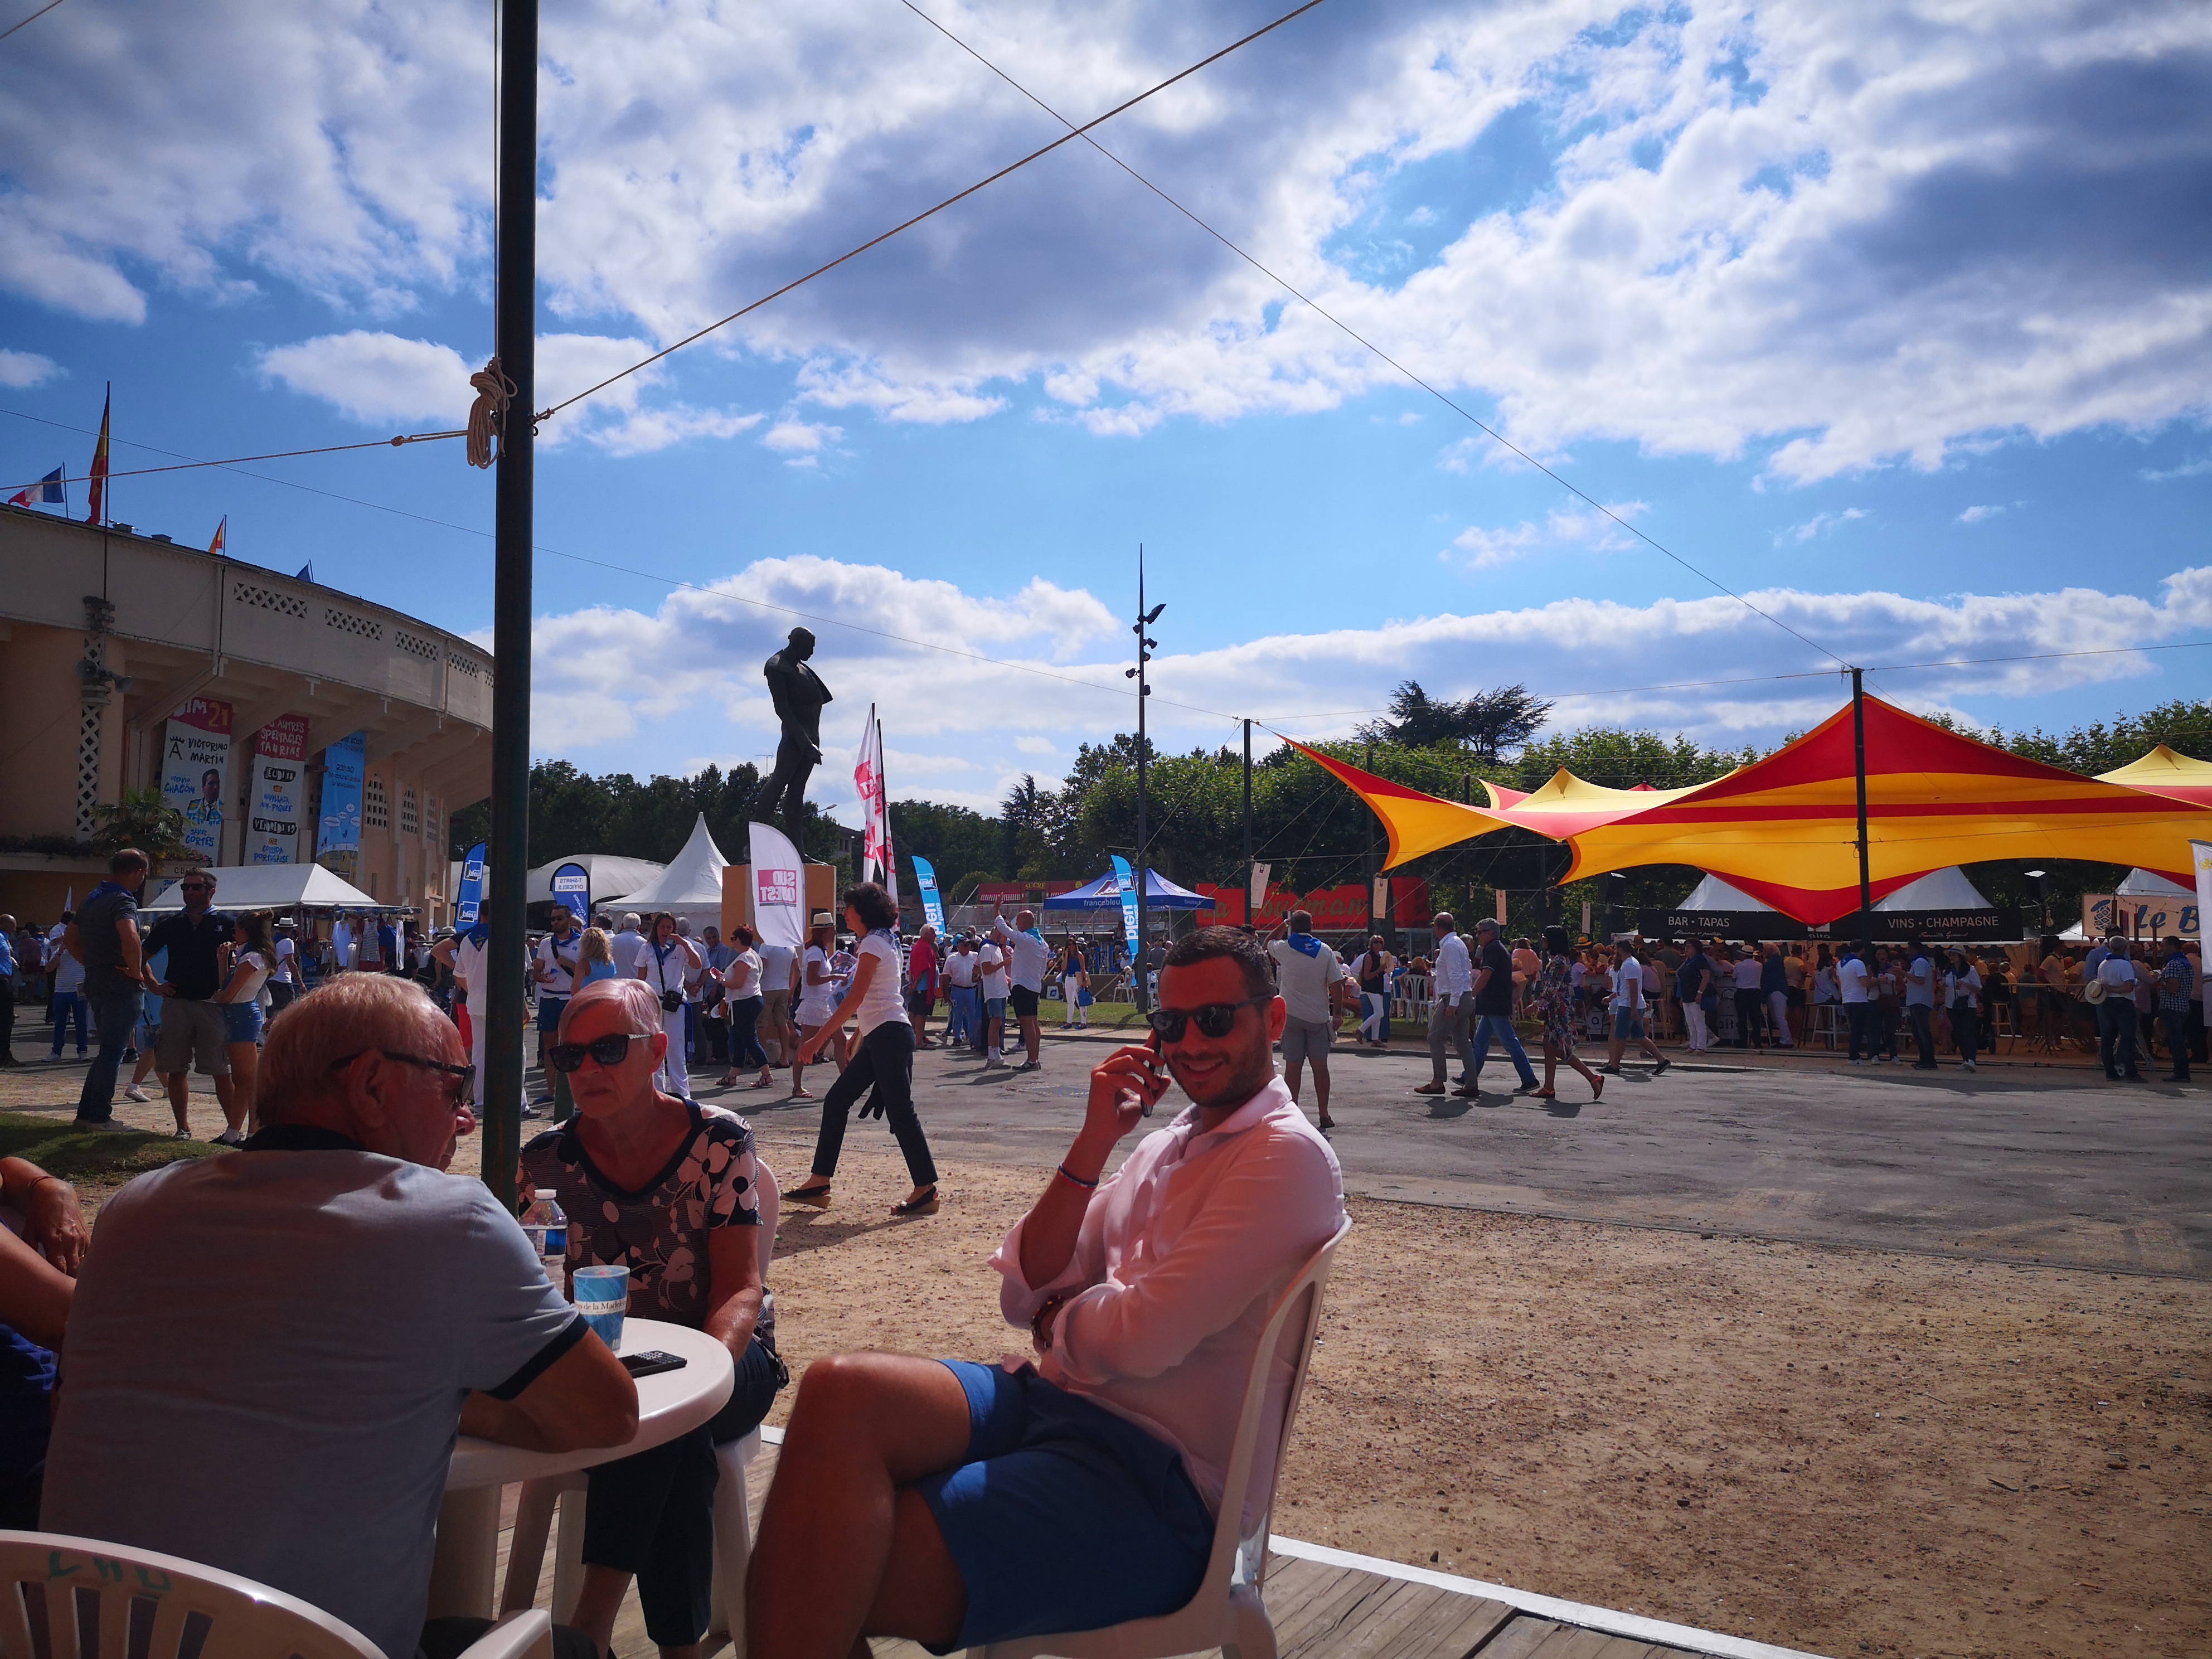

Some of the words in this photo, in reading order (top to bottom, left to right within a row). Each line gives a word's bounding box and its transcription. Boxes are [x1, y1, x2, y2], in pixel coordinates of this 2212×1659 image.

[208, 701, 229, 727] 21
[278, 719, 304, 734] AUTRES
[260, 727, 303, 746] SPECTACLES
[188, 738, 228, 751] VICTORINO
[260, 741, 300, 758] TAURINS
[265, 768, 284, 780] JEUDI
[255, 819, 284, 833] VENDREDI
[462, 910, 476, 918] bleu
[2138, 904, 2166, 929] Le
[1668, 916, 1689, 926] BAR
[1698, 917, 1730, 927] TAPAS
[1888, 918, 1914, 929] VINS
[1926, 916, 1999, 928] CHAMPAGNE
